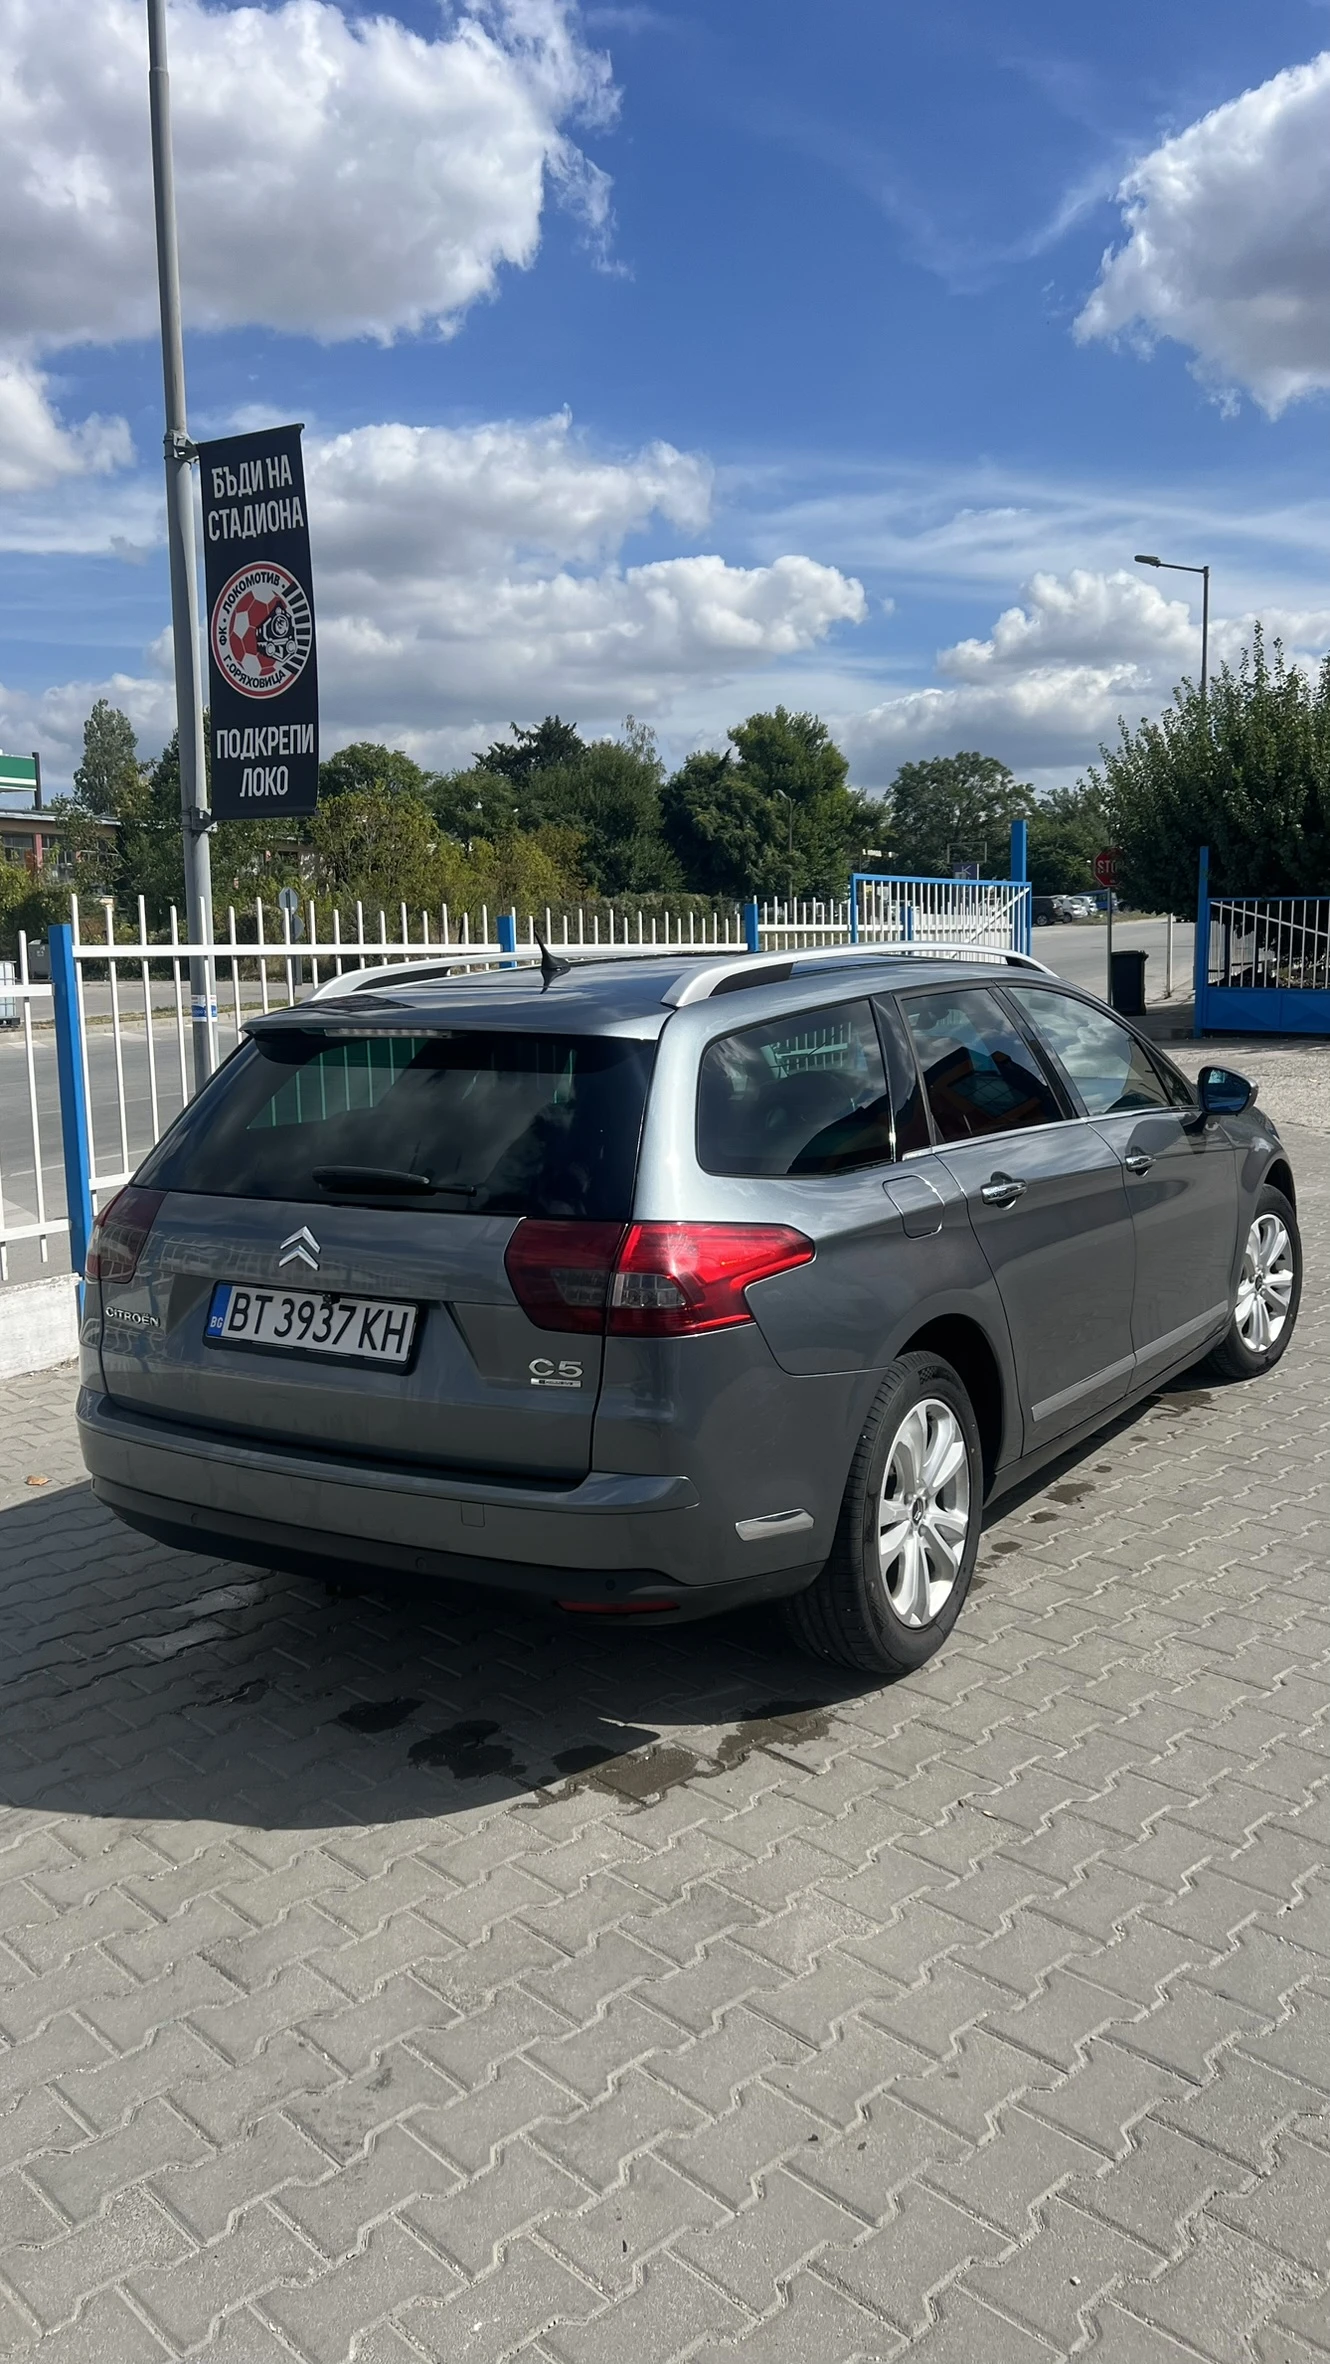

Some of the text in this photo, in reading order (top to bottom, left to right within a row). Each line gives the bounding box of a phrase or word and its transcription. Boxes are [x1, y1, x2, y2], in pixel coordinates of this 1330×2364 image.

[211, 454, 293, 498] БЪДИ НА
[208, 496, 304, 541] СТАДИОНА
[223, 571, 281, 614] ЛОКОМОТИВ
[216, 723, 314, 760] ПОДКРЕПИ
[239, 765, 289, 798] ЛОКО
[105, 1306, 160, 1327] CITROËN
[210, 1315, 224, 1329] BG
[529, 1358, 582, 1378] C5
